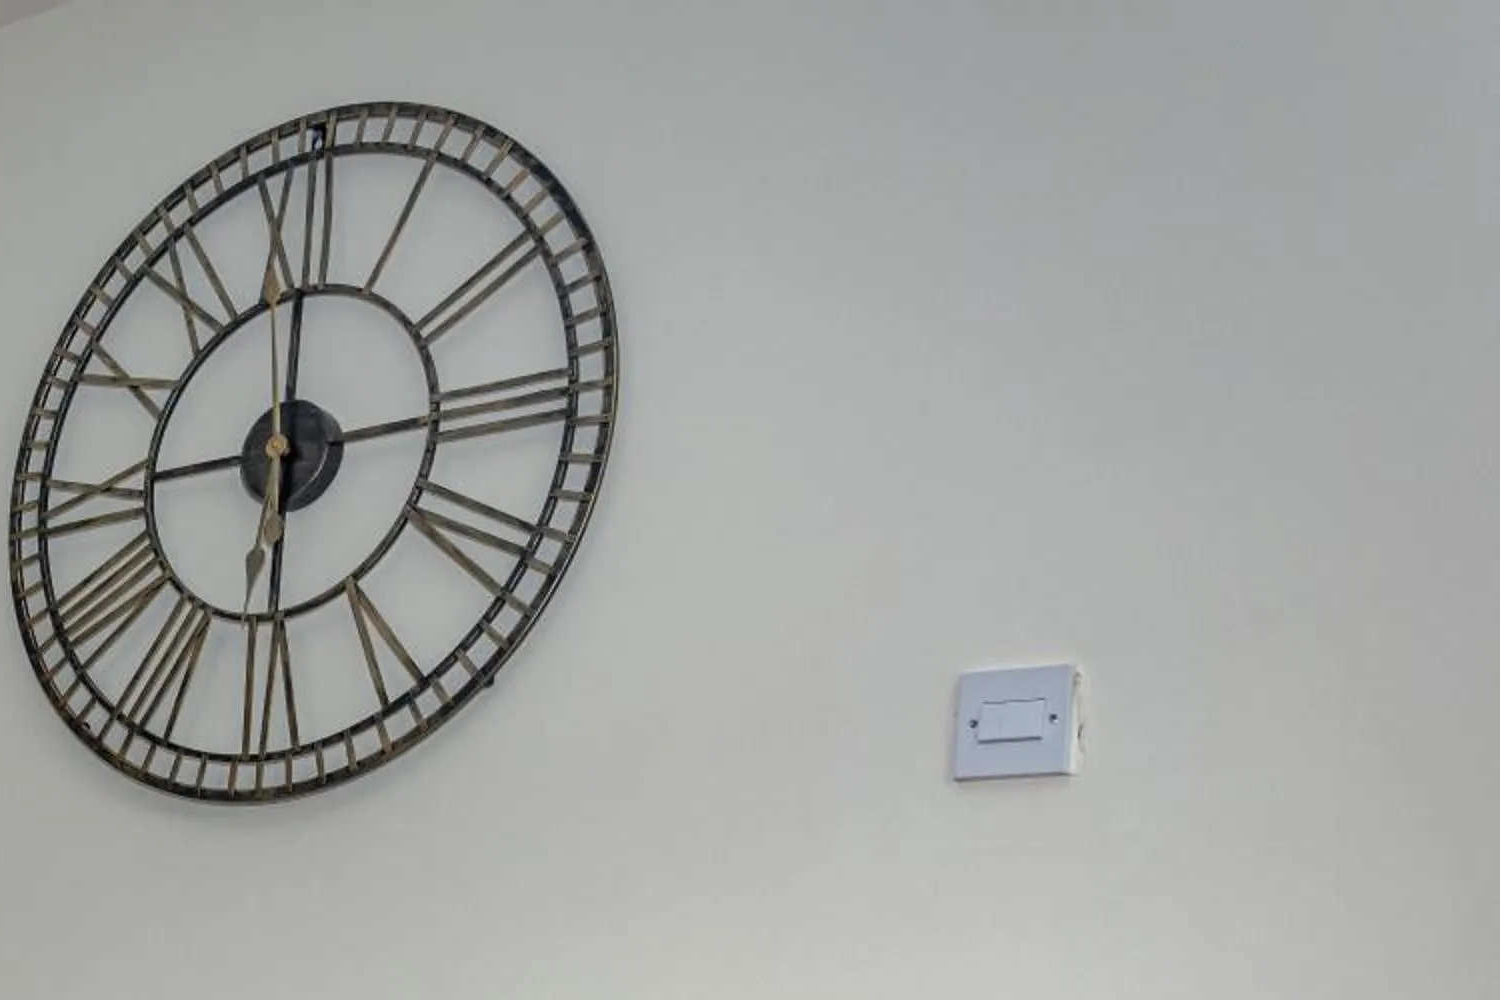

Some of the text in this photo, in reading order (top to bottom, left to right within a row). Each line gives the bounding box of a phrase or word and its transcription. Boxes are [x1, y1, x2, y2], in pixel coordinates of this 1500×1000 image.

[256, 152, 333, 292] XII
[141, 222, 238, 358] XI
[412, 228, 544, 347] II
[77, 338, 180, 421] X
[433, 366, 570, 444] III
[45, 457, 150, 538] IX
[346, 575, 430, 706] V
